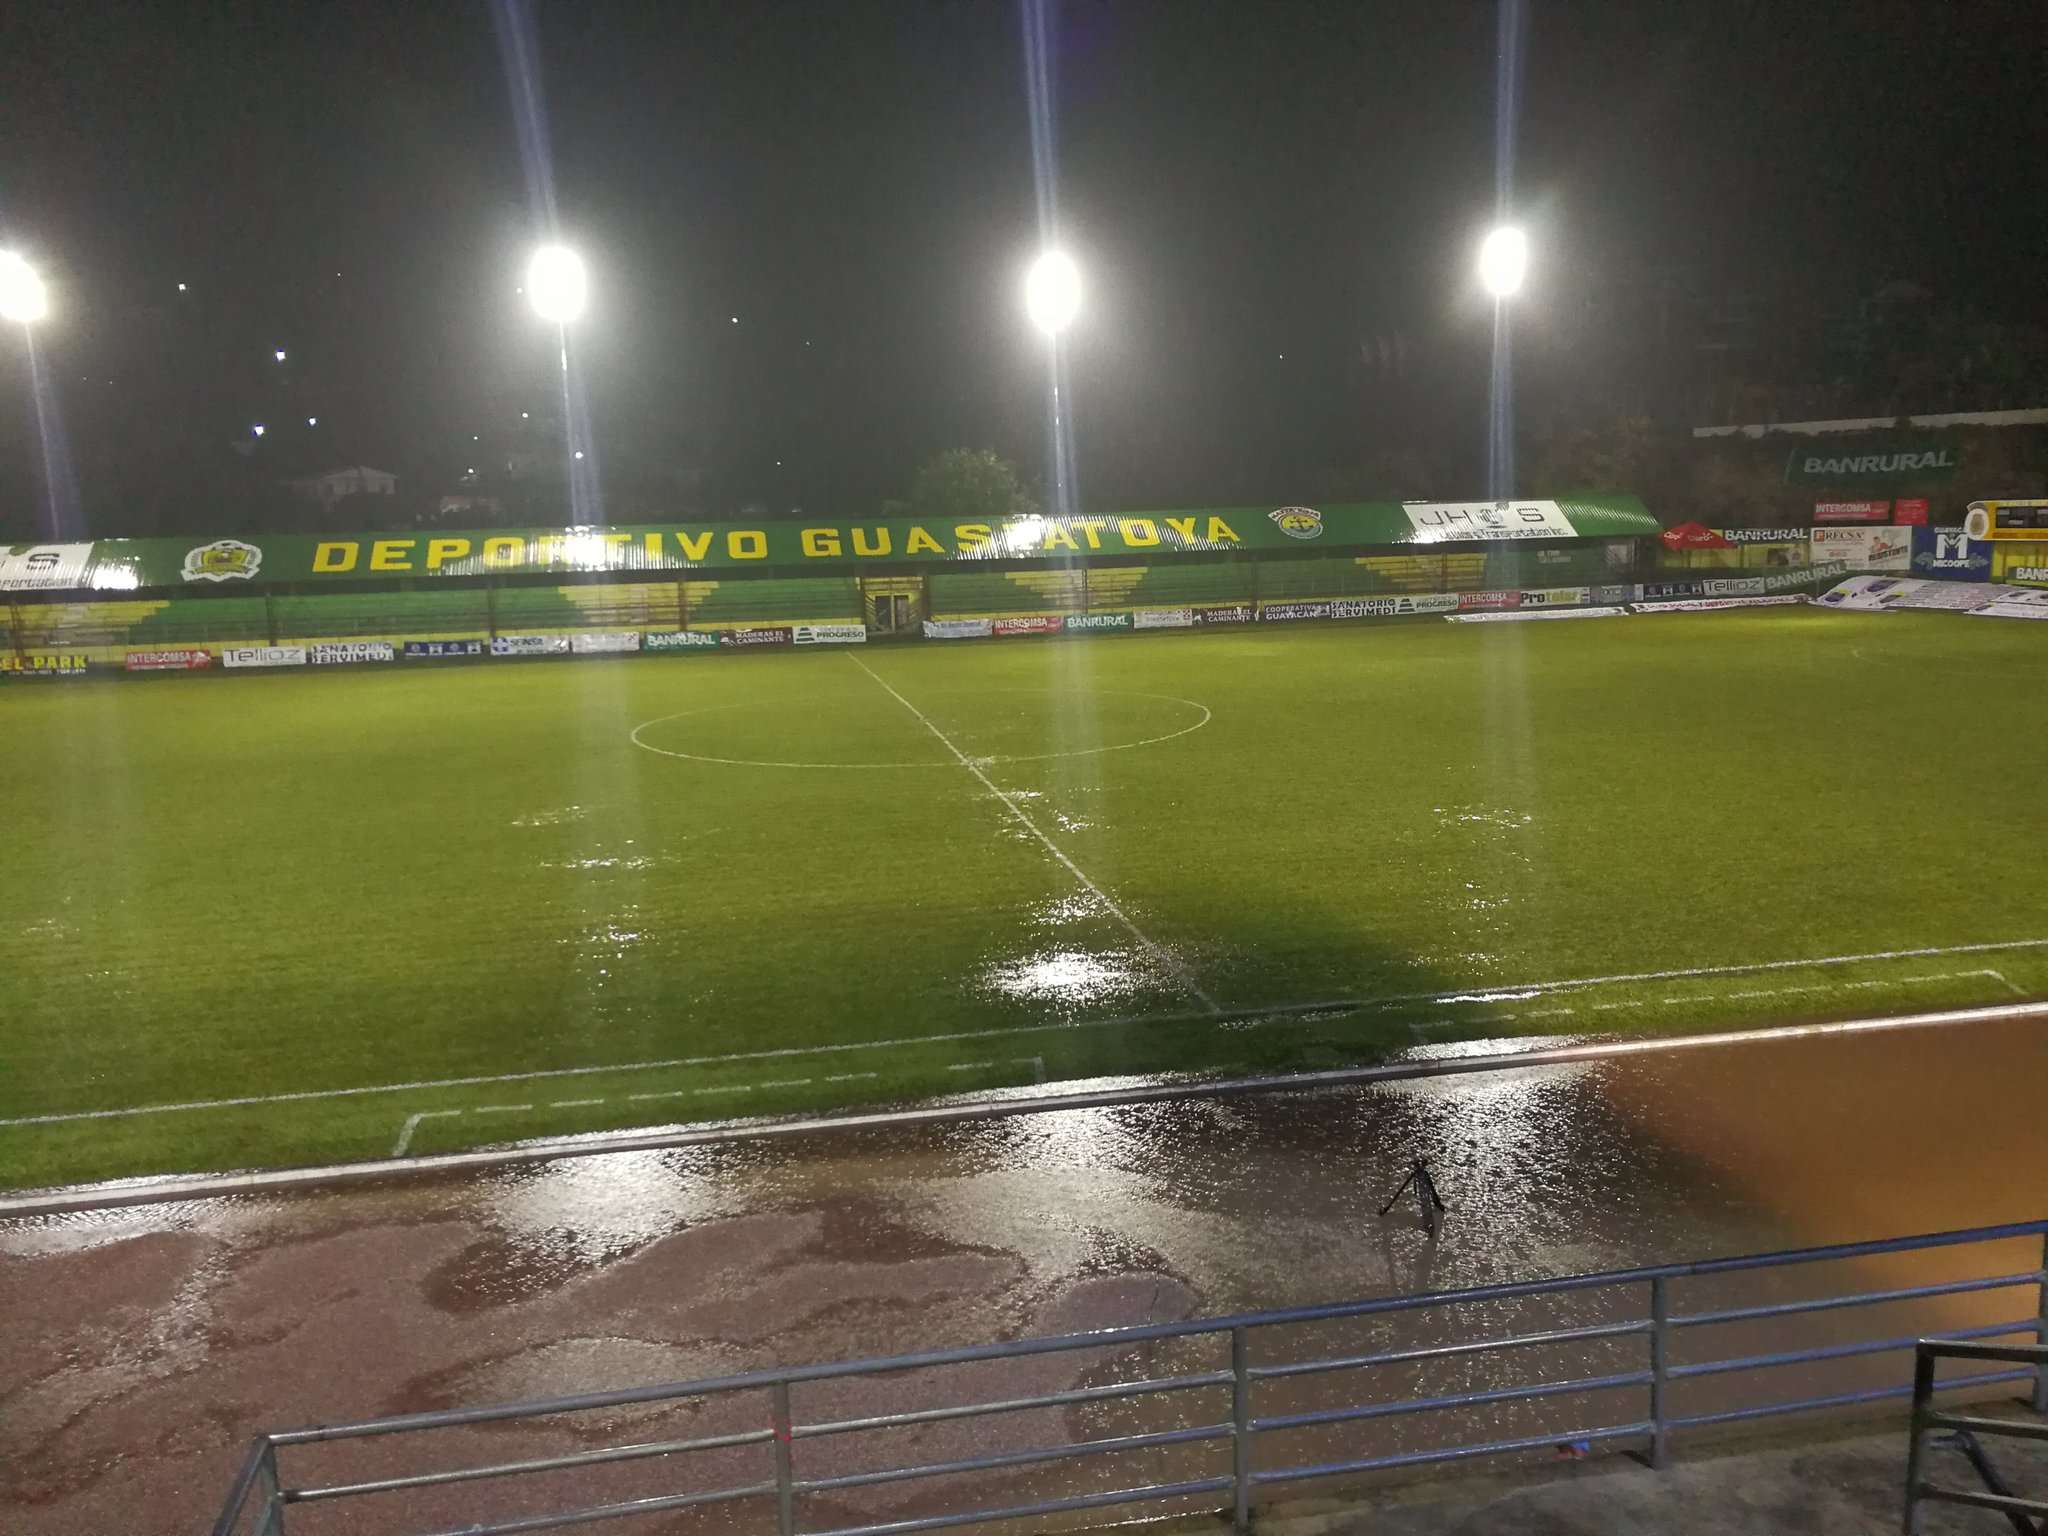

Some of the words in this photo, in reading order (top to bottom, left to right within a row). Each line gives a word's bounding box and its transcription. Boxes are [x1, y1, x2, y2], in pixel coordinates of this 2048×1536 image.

[1804, 451, 1953, 473] BANRURAL
[1815, 503, 1871, 513] INTERCOMSA
[801, 516, 1241, 557] GUASATOYA
[1725, 528, 1808, 541] BANRURAL
[1765, 563, 1847, 589] BANRURAL
[1331, 599, 1396, 609] SANATORIO
[1417, 599, 1458, 608] PROGRESO
[1067, 614, 1128, 628] BANRURAL
[647, 632, 716, 647] BANRURAL
[34, 656, 86, 669] PARK
[128, 651, 190, 663] INTERCOMSA
